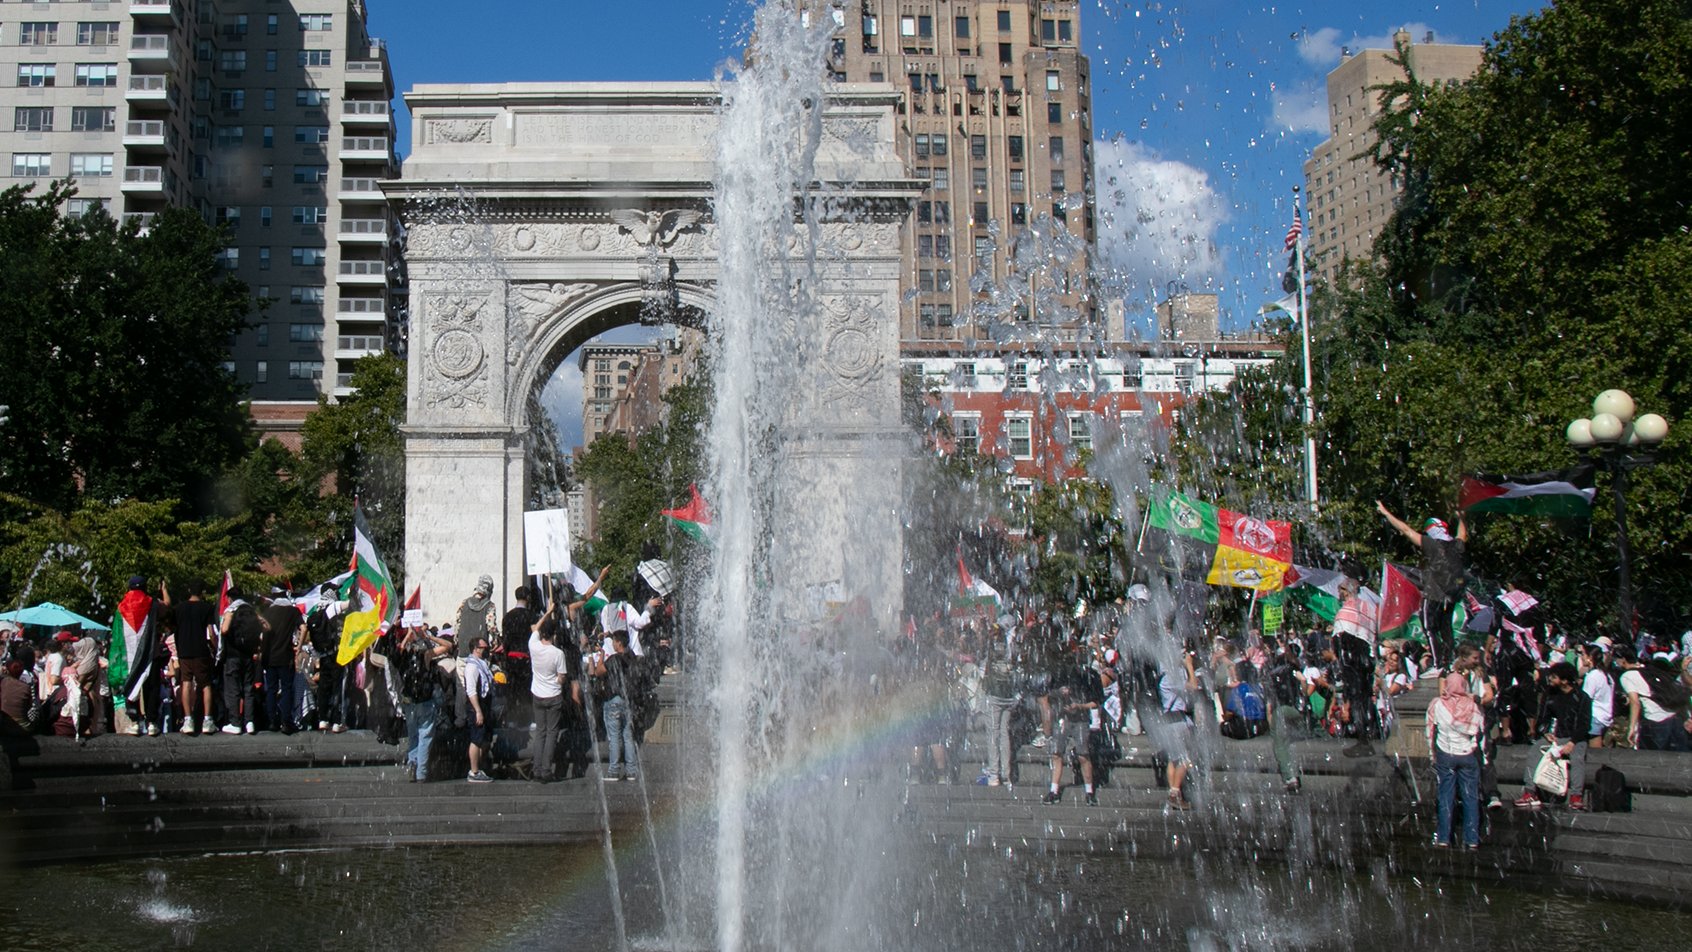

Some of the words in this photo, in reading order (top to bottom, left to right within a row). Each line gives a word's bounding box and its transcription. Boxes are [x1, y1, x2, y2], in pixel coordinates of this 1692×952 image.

[549, 125, 572, 134] THE
[577, 125, 621, 134] HONEST
[658, 125, 696, 134] REPAIR
[522, 134, 532, 144] IS
[536, 134, 546, 144] IN
[551, 134, 573, 144] THE
[616, 134, 631, 144] OF
[636, 134, 660, 144] GOD
